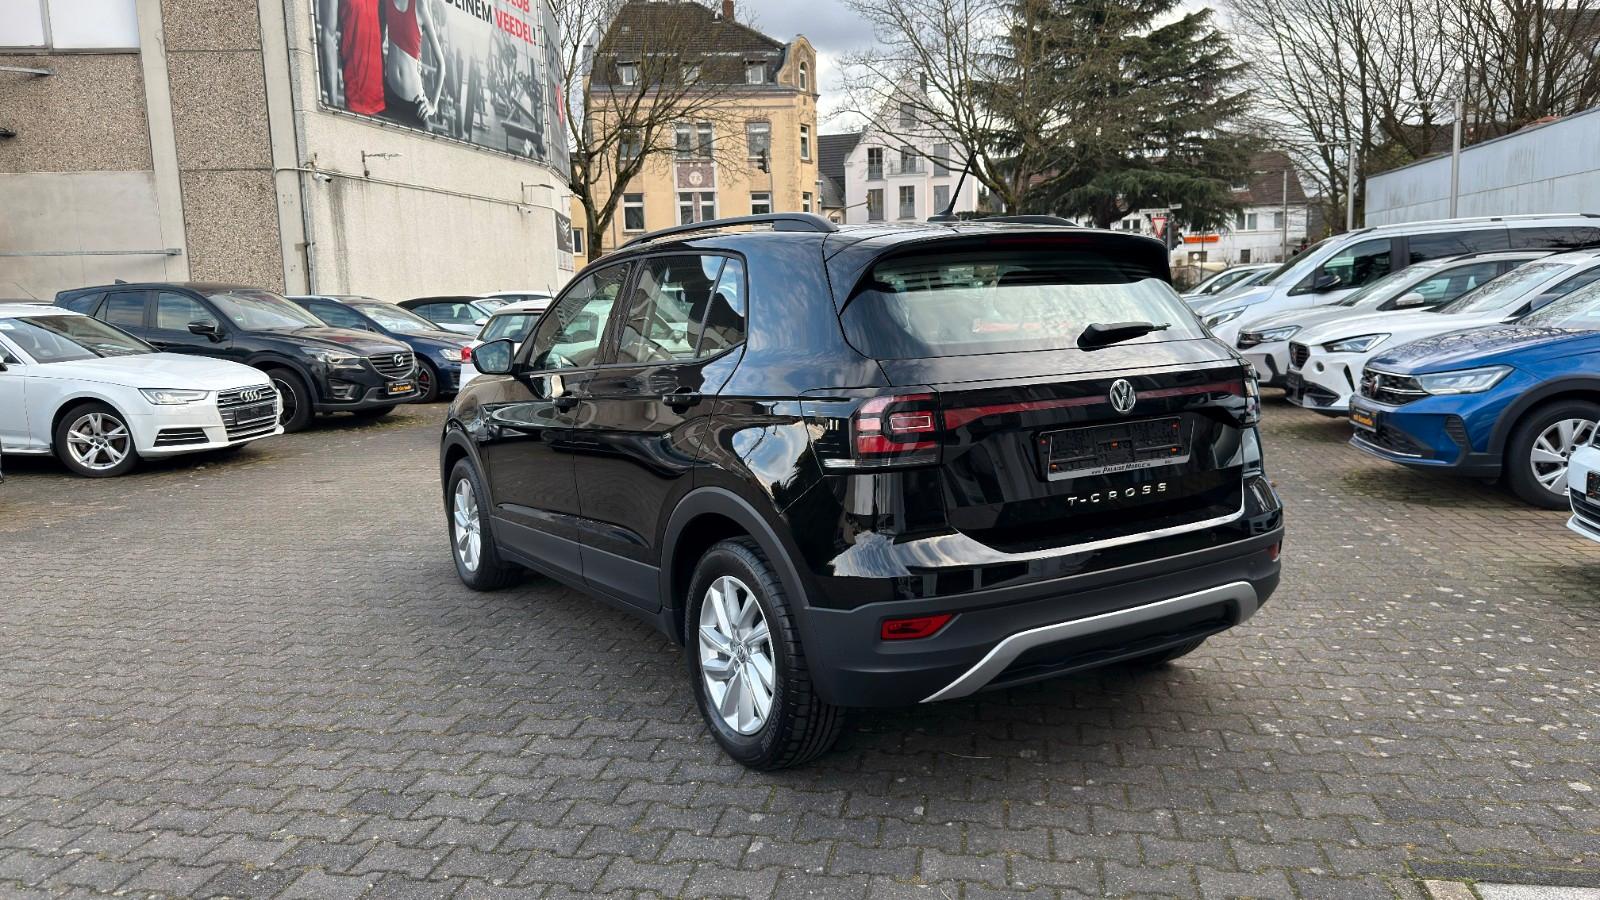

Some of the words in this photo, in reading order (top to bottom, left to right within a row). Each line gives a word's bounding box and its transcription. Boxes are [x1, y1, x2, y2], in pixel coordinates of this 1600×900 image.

[506, 0, 530, 12] UB
[445, 0, 493, 25] INEM
[494, 7, 537, 46] VEEDEL!
[1067, 482, 1167, 507] T-CROSS
